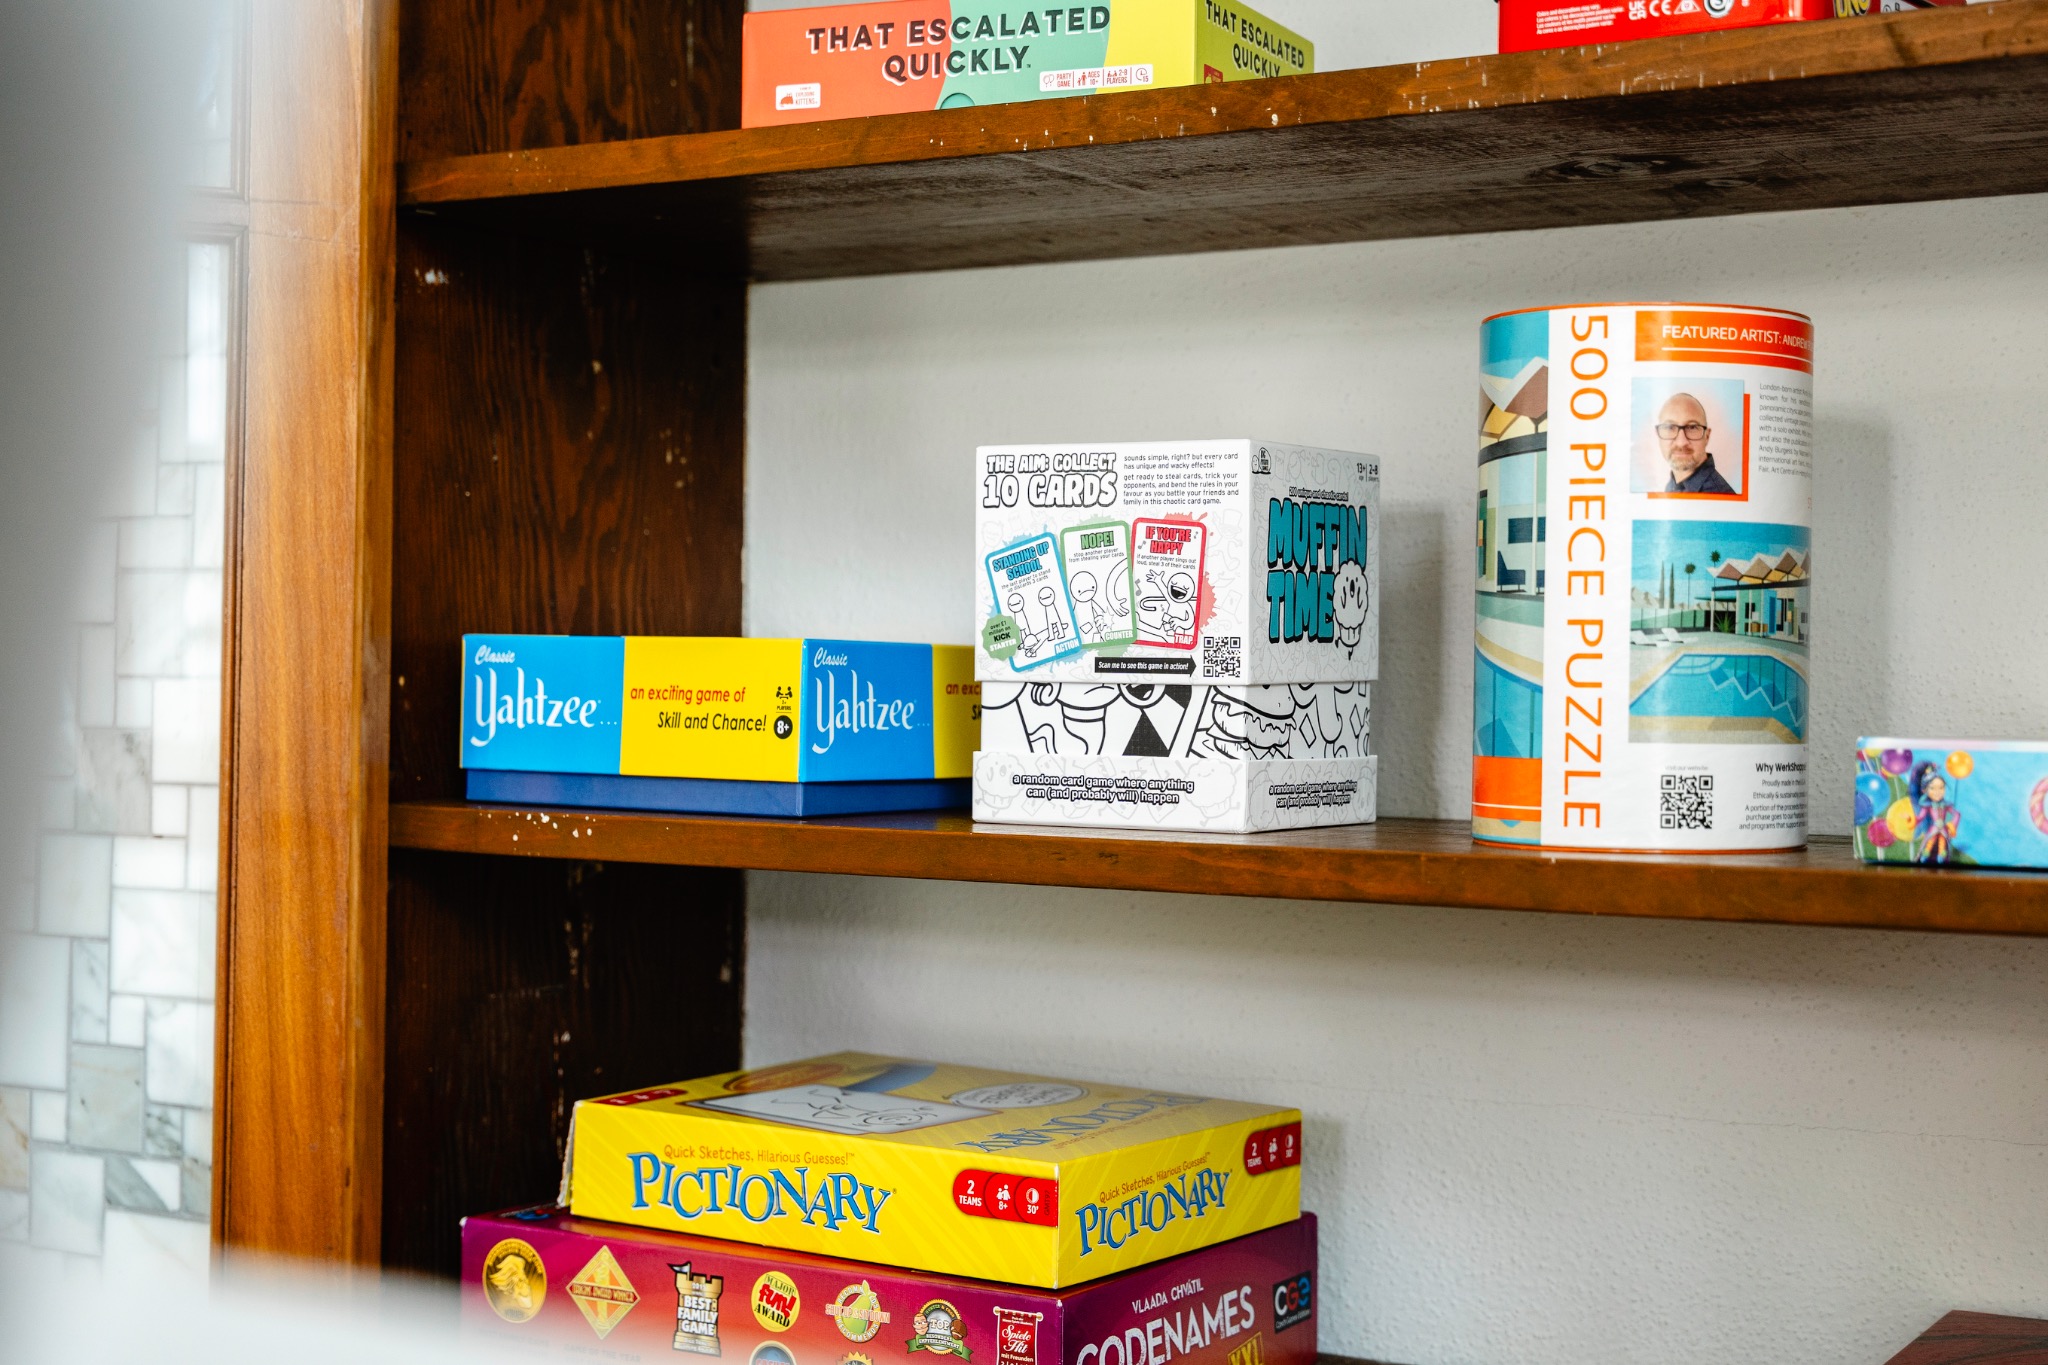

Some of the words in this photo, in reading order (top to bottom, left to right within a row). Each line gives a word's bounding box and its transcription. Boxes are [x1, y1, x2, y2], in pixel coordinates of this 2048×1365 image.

[806, 22, 895, 54] THAT
[906, 6, 1110, 48] ESCALATED
[1205, 0, 1236, 34] THAT
[1241, 18, 1305, 69] ESCALATED
[1056, 72, 1072, 80] PARTY
[1057, 80, 1071, 88] GAME
[1106, 76, 1128, 84] PLAYERS
[1662, 325, 1738, 341] FEATURED
[1740, 329, 1782, 344] ARTIST:
[1570, 315, 1609, 420] 500
[987, 454, 1015, 474] THE
[1018, 454, 1049, 474] AIM:
[1053, 452, 1116, 473] COLLECT
[1148, 454, 1170, 462] simple,
[1171, 462, 1189, 470] wacky
[983, 474, 1019, 508] 10
[1028, 471, 1118, 508] CARDS
[1568, 443, 1606, 596] PIECE
[1080, 531, 1115, 550] NOPE!
[1145, 526, 1156, 540] IF
[1156, 527, 1191, 542] YOU'RE
[1268, 498, 1367, 573] MUFFIN
[992, 546, 1037, 572] STANDING
[1036, 541, 1050, 556] UP
[1150, 540, 1184, 556] HAPPY
[1006, 558, 1043, 581] SCHOOL
[1267, 569, 1336, 643] TIME
[994, 632, 1011, 642] KICK
[1105, 630, 1134, 641] COUNTER
[1175, 634, 1193, 644] TRAP
[990, 639, 1017, 652] STARTER
[1055, 639, 1080, 654] ACTION
[475, 645, 516, 666] Classic
[814, 647, 848, 668] Classic
[1137, 662, 1147, 670] this
[1163, 662, 1169, 670] in
[1170, 662, 1189, 670] action!
[630, 688, 644, 700] an
[648, 685, 693, 705] exciting
[696, 689, 730, 705] game
[734, 687, 746, 702] of
[946, 683, 959, 695] an
[658, 712, 682, 729] Skill
[684, 713, 709, 730] and
[712, 713, 767, 732] Chance!
[776, 720, 790, 734] 8+
[1564, 620, 1604, 828] PUZZLE
[1756, 763, 1774, 775] Why
[1013, 776, 1020, 785] a
[1021, 774, 1060, 786] random
[1061, 775, 1084, 787] card
[1085, 777, 1114, 789] game
[1116, 777, 1147, 790] where
[1148, 779, 1194, 794] anything
[1026, 788, 1045, 799] can
[1046, 787, 1070, 800] (and
[1071, 788, 1116, 803] probably
[1118, 791, 1140, 804] will)
[1140, 791, 1179, 805] happen
[663, 1144, 695, 1161] Quick
[699, 1146, 754, 1163] Sketches,
[757, 1150, 801, 1163] Hilarious
[1252, 1143, 1257, 1156] 2
[1247, 1157, 1262, 1168] TEAMS
[626, 1151, 892, 1233] PICTIONARY
[967, 1180, 975, 1195] 2
[1100, 1186, 1120, 1204] Quick
[1122, 1175, 1155, 1195] Sketches,
[1156, 1166, 1182, 1182] Hilarious
[959, 1195, 982, 1207] TEAMS
[998, 1201, 1008, 1210] 8+
[1075, 1167, 1230, 1258] PICTIONARY
[766, 1276, 795, 1295] MAJOR
[684, 1295, 712, 1310] BEST
[1132, 1292, 1168, 1314] VLAADA
[1171, 1278, 1204, 1301] CHVÁTIL
[678, 1307, 718, 1324] FAMILY
[754, 1304, 790, 1328] AWARD
[930, 1318, 950, 1330] TOP
[681, 1320, 715, 1336] GAME
[1002, 1324, 1032, 1341] Spiele
[1076, 1285, 1255, 1365] CODENAMES
[1010, 1354, 1034, 1362] Freunden
